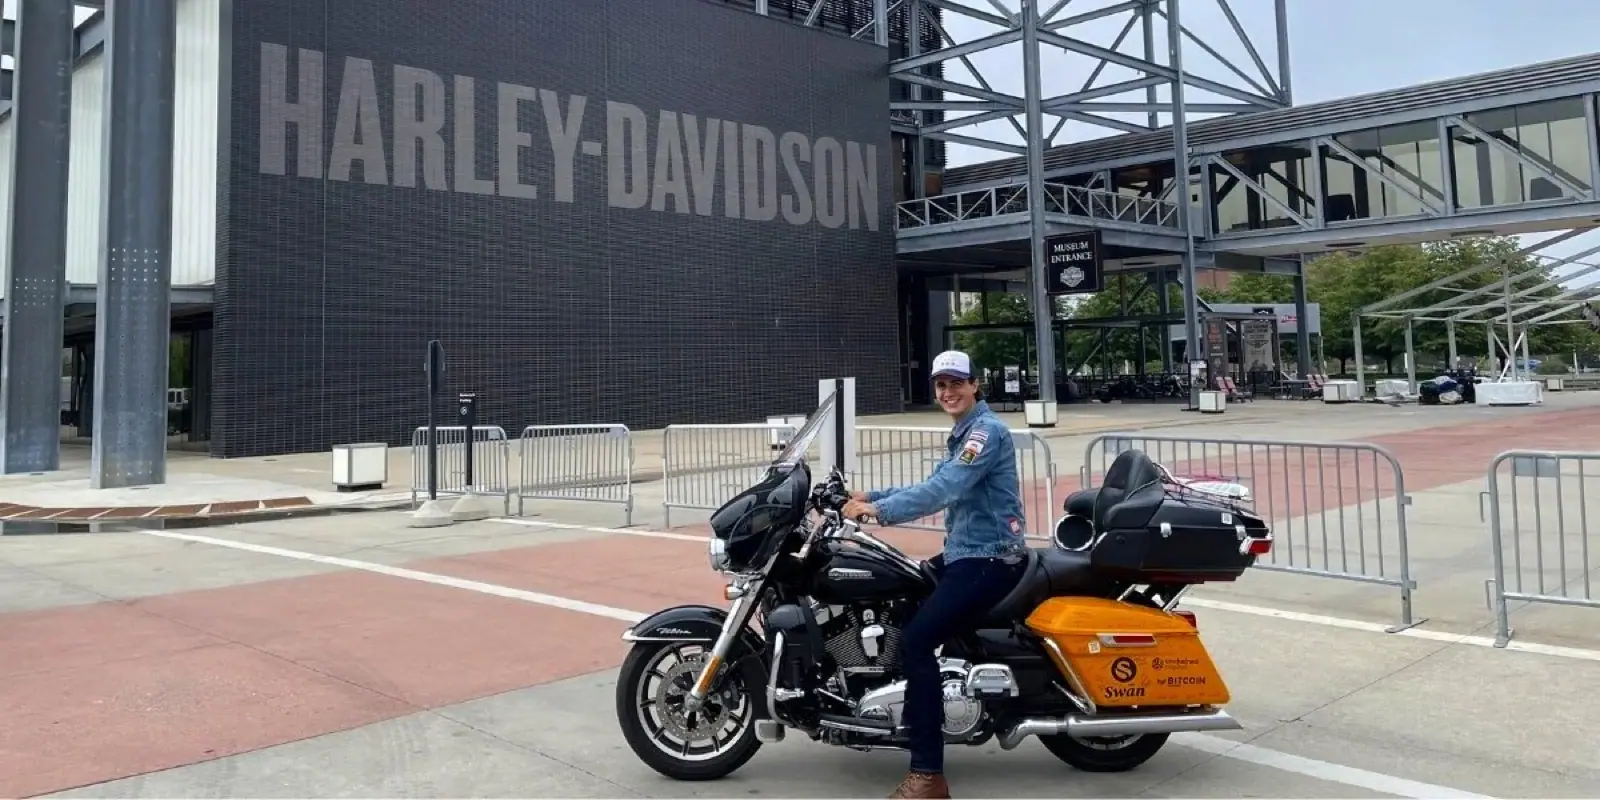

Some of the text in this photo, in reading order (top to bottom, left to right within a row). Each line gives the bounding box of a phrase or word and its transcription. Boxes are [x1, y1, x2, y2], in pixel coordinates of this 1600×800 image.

[259, 42, 879, 231] HARLEY-DAVIDSON
[1054, 241, 1089, 252] MUSEUM
[1051, 252, 1093, 264] ENTRANCE
[1167, 676, 1206, 685] BITCOIN
[1104, 686, 1145, 698] Swan
